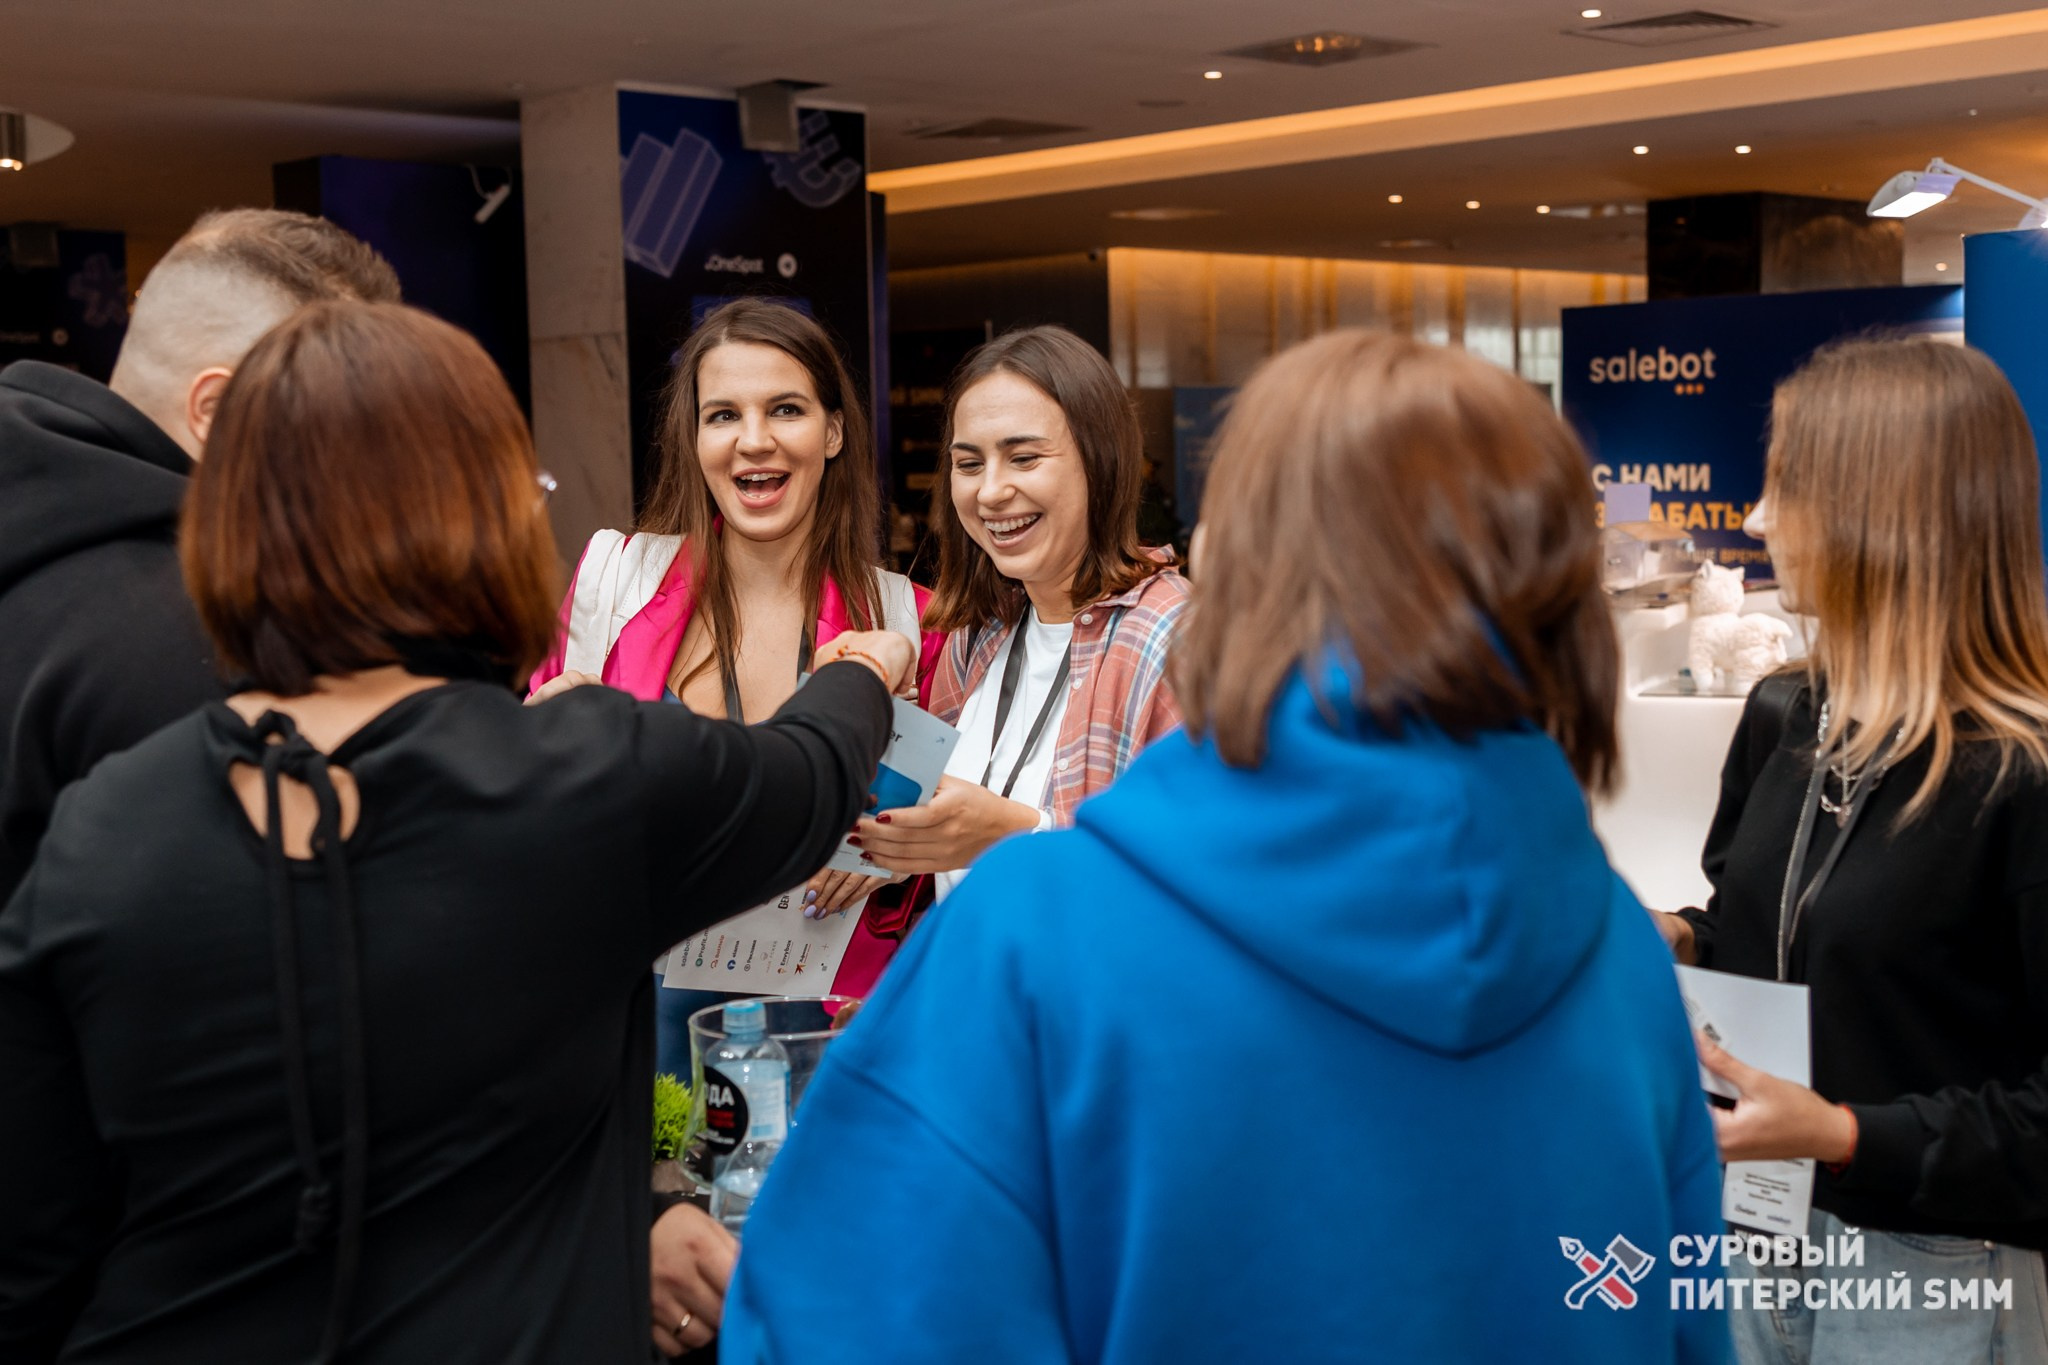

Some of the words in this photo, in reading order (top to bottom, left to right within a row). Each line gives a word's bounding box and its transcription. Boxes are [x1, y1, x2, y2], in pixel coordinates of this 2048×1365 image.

[1589, 346, 1716, 383] salebot
[1592, 464, 1613, 492] С
[1619, 464, 1711, 492] НАМИ
[699, 928, 709, 958] Profit.m
[704, 1084, 735, 1107] ДА
